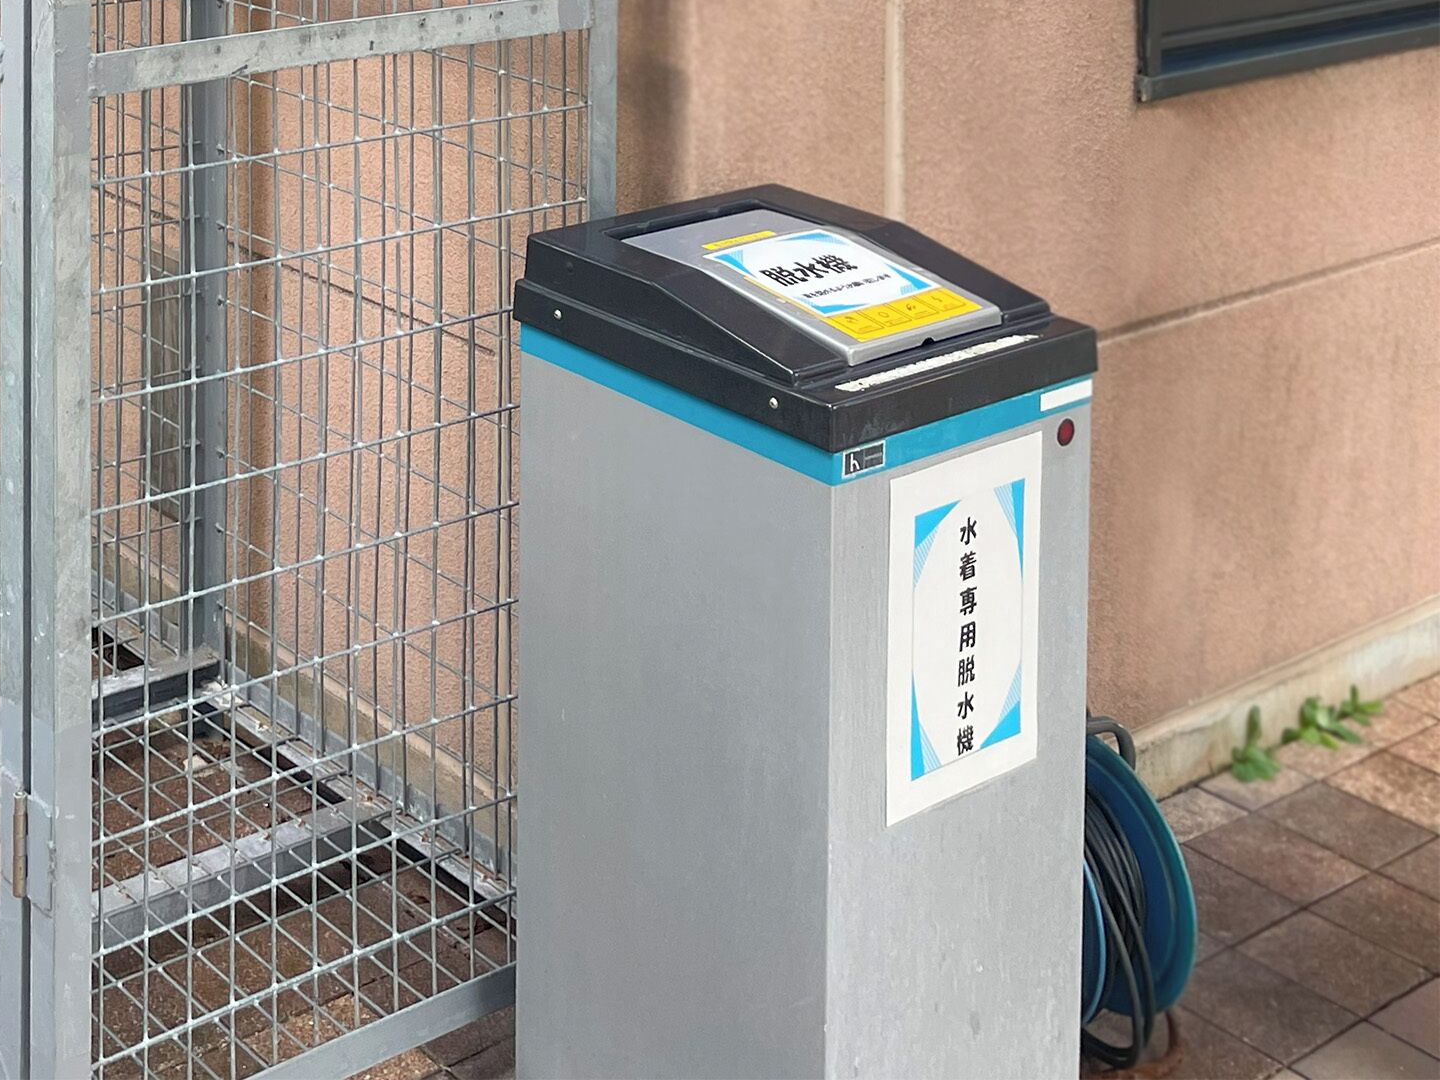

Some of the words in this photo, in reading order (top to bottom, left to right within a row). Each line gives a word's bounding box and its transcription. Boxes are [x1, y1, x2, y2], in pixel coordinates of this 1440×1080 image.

[760, 254, 858, 287] 脱水機
[957, 517, 978, 756] 水着専用脱水機
